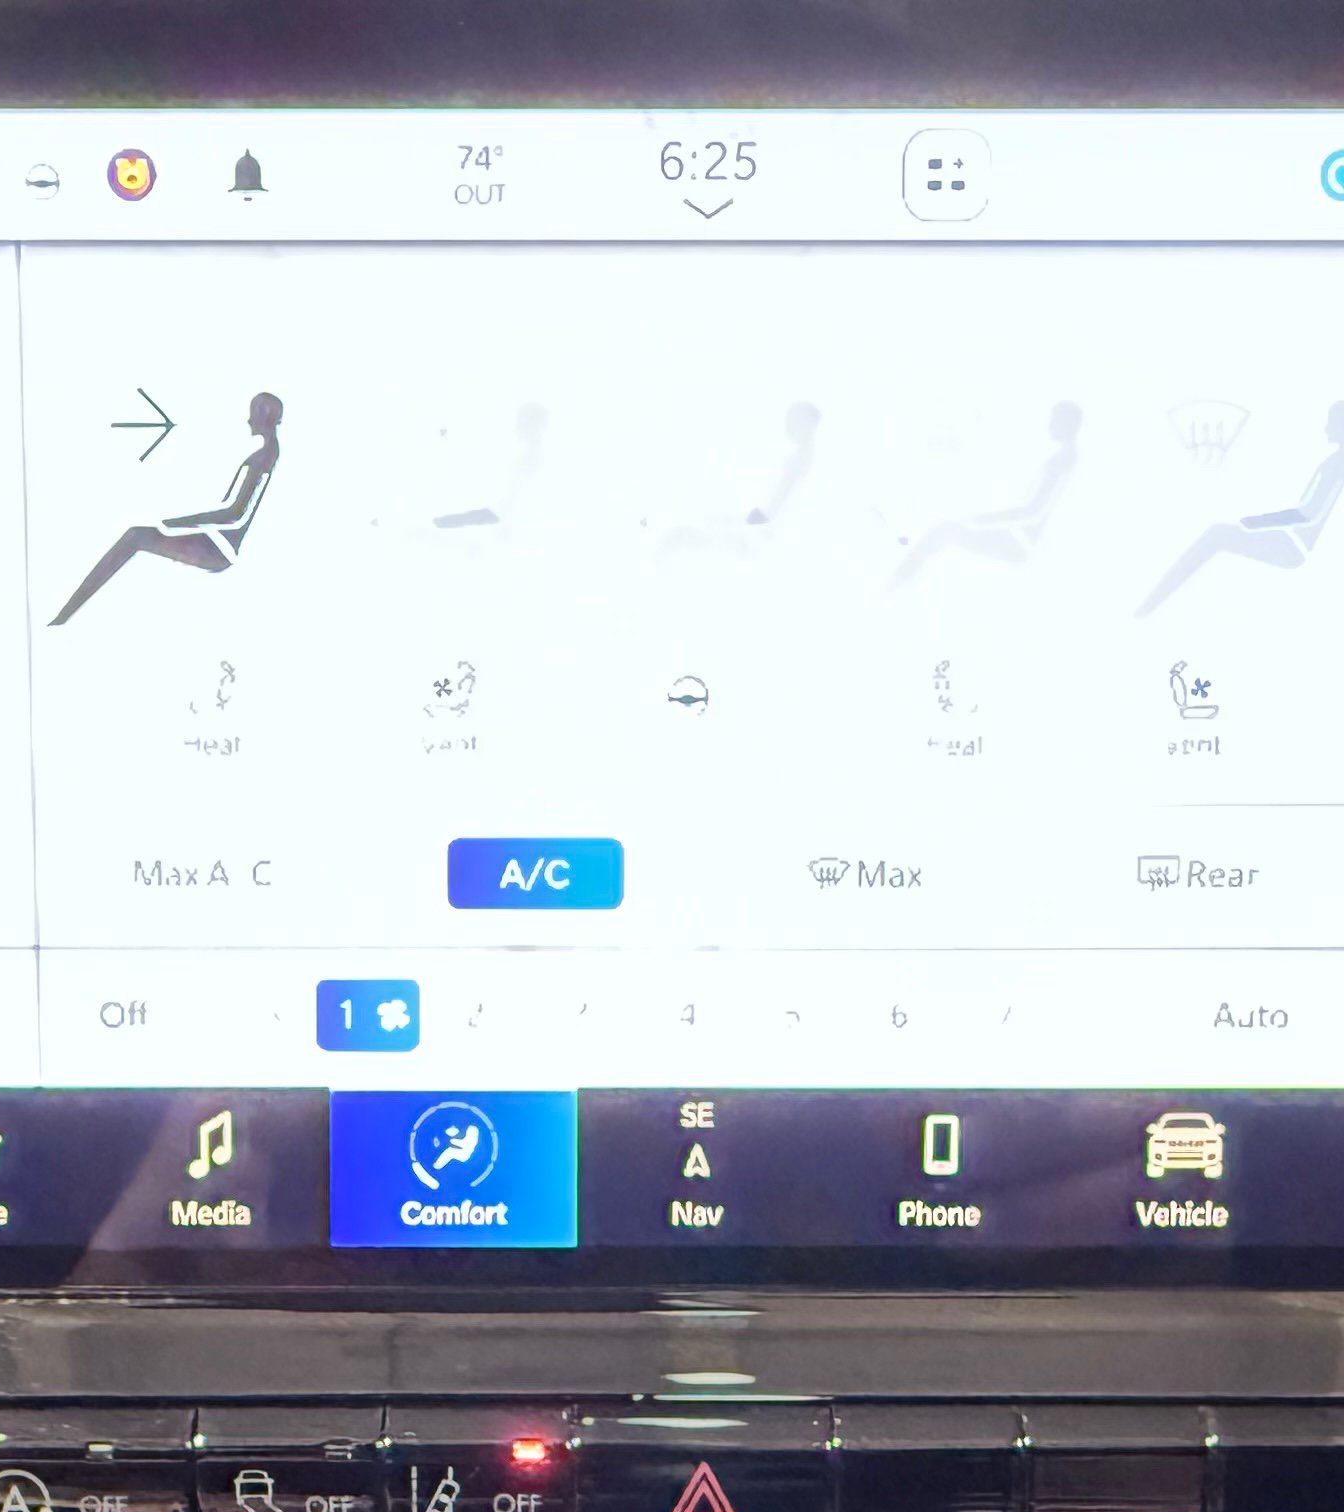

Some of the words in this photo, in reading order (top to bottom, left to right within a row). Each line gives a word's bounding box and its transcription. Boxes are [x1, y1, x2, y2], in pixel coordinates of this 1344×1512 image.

[661, 142, 756, 180] 6:25
[455, 184, 505, 204] OUT
[135, 861, 197, 886] Max
[500, 858, 569, 891] A/C
[859, 861, 920, 888] Max
[1188, 861, 1259, 887] Rear
[100, 1001, 146, 1028] Off
[340, 1000, 351, 1029] 1
[1214, 1003, 1288, 1028] Auto
[680, 1102, 714, 1127] SE
[172, 1200, 251, 1225] Media
[401, 1200, 508, 1225] Comfort
[672, 1201, 724, 1226] Nav
[899, 1200, 981, 1226] Phone
[1136, 1200, 1228, 1227] Vehicle
